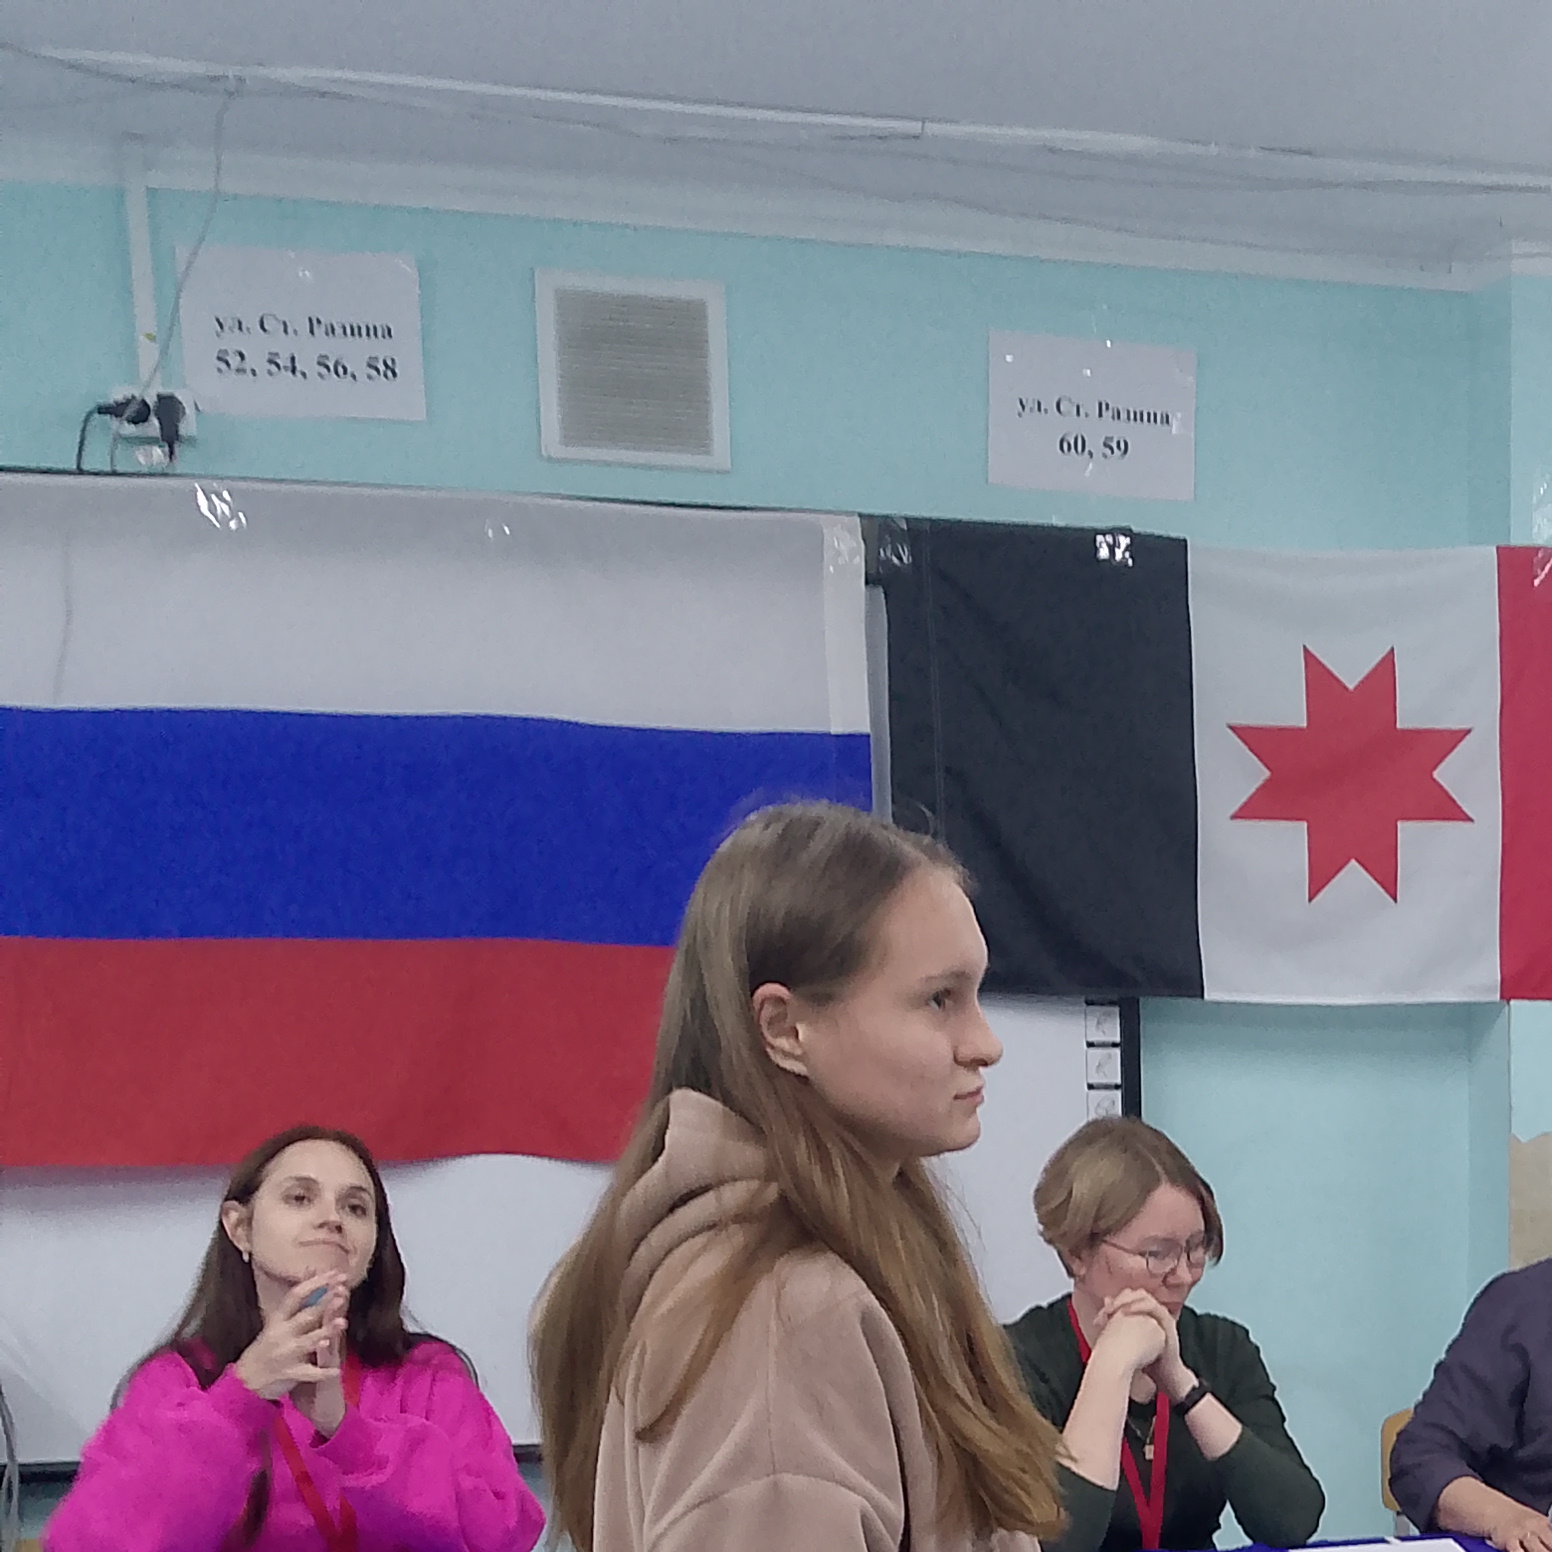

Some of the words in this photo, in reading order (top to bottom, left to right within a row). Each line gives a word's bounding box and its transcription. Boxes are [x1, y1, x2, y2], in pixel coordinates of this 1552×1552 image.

[214, 315, 251, 338] ул.
[258, 312, 298, 337] Ст.
[307, 315, 394, 340] Разина
[216, 348, 257, 377] 52,
[266, 351, 308, 380] 54,
[316, 353, 357, 382] 56,
[366, 354, 398, 382] 58
[1017, 397, 1049, 418] ул.
[1055, 395, 1090, 418] Ст.
[1097, 399, 1171, 426] Разина
[1058, 433, 1094, 459] 60,
[1101, 435, 1130, 460] 59
